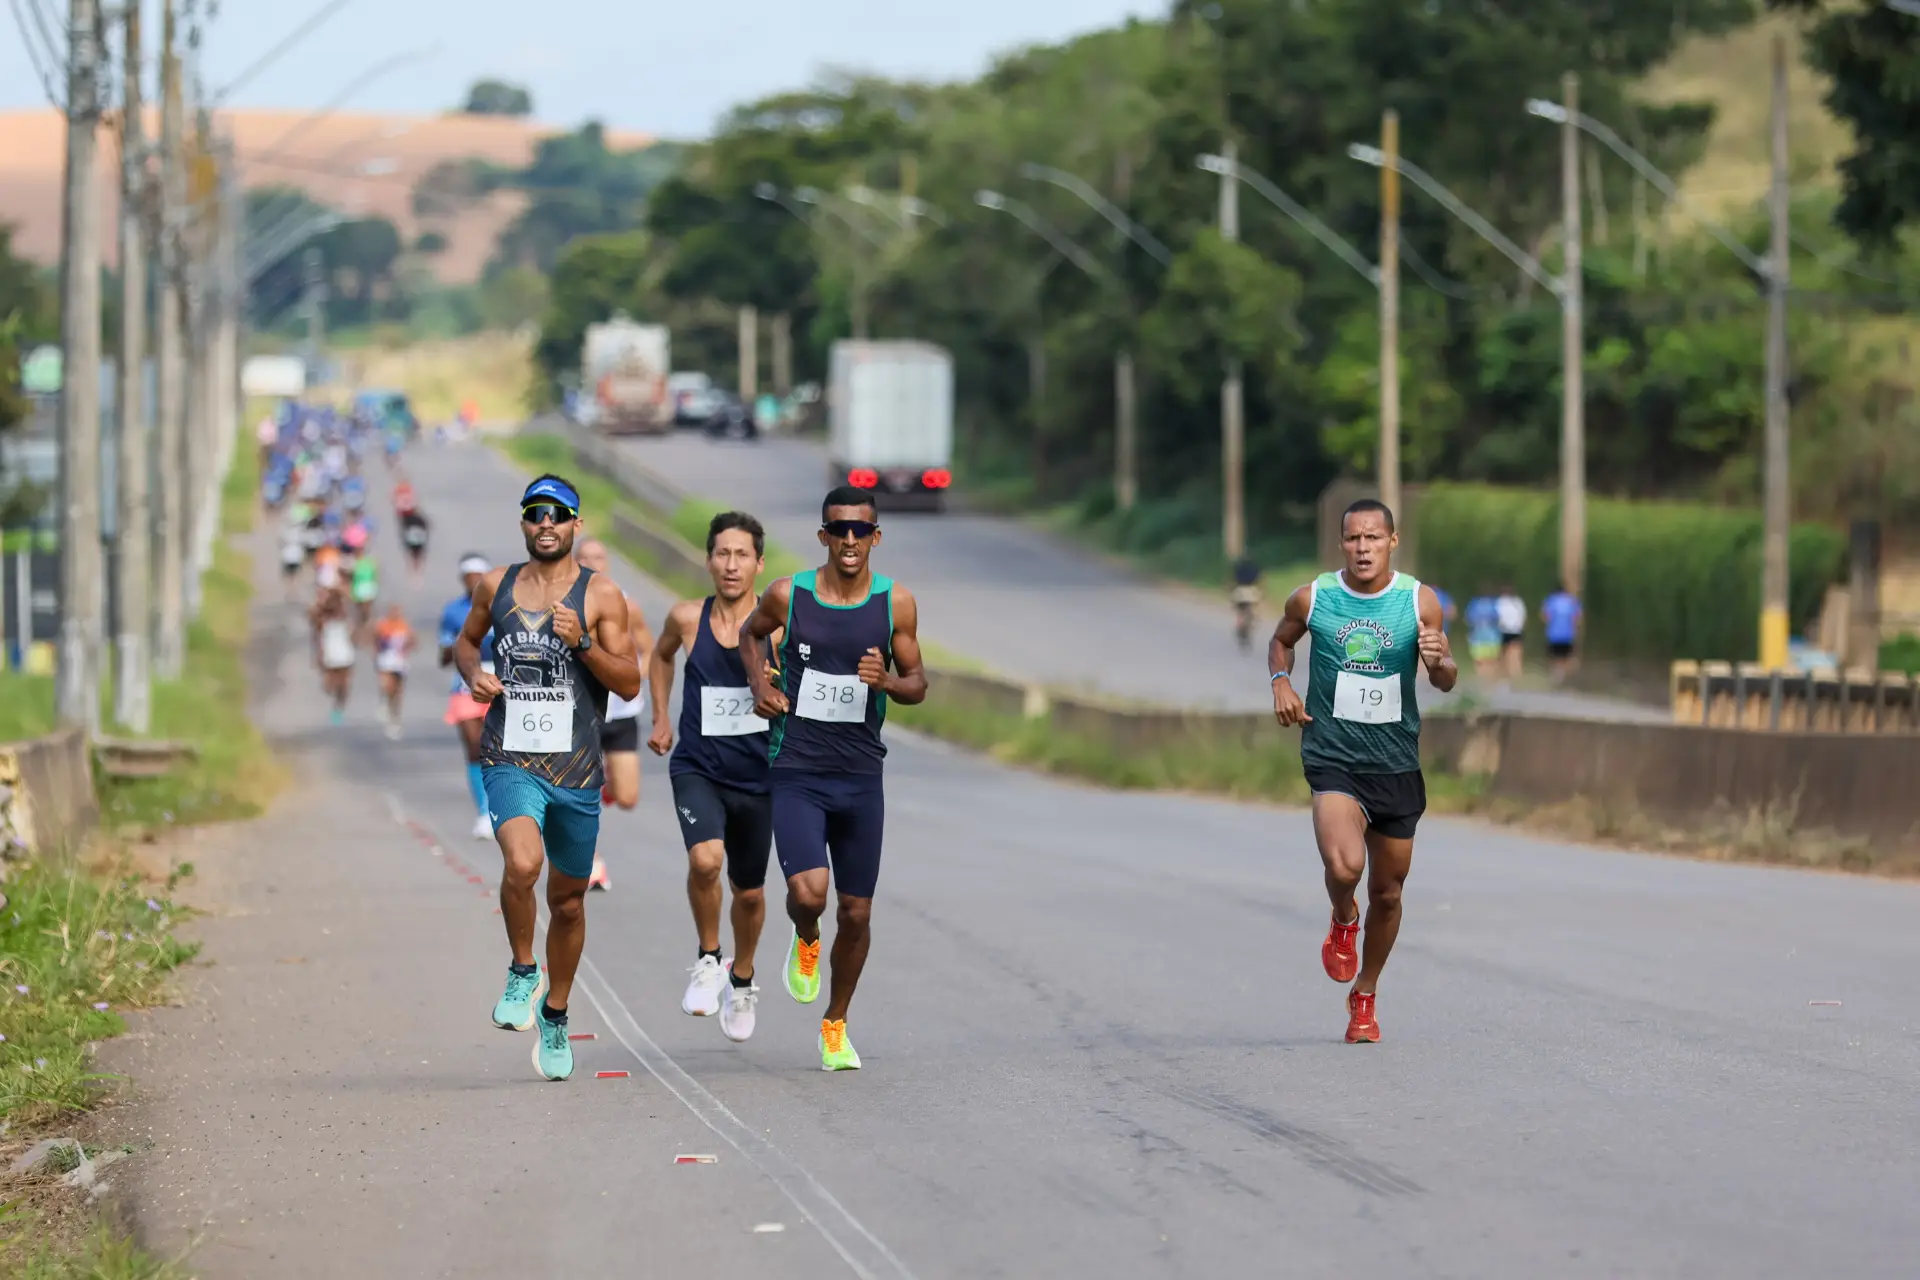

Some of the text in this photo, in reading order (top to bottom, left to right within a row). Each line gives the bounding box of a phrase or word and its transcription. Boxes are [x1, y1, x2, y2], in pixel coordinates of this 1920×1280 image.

[497, 631, 573, 662] FIT BRASIL
[509, 691, 566, 702] ROUPAS
[812, 682, 854, 704] 318
[1359, 688, 1383, 706] 19
[522, 713, 553, 732] 66
